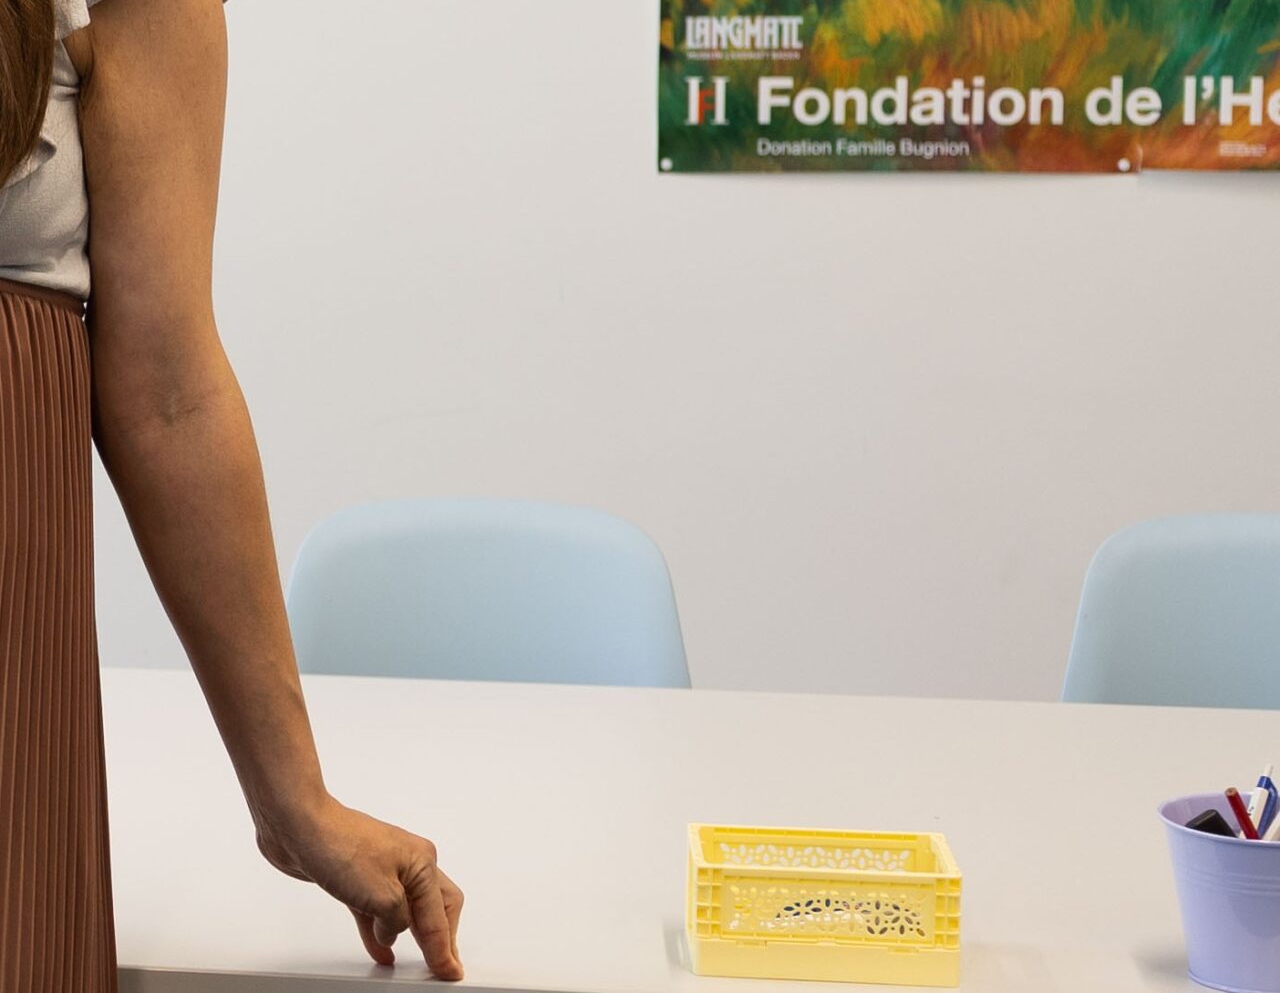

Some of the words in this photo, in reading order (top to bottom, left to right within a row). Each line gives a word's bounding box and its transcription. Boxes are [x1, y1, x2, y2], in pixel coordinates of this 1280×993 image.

[685, 16, 804, 50] LANGMATT
[757, 76, 1066, 126] Fondation
[1084, 76, 1163, 126] de
[756, 137, 831, 157] Donation
[835, 137, 897, 157] Famille
[899, 137, 970, 160] Bugnion
